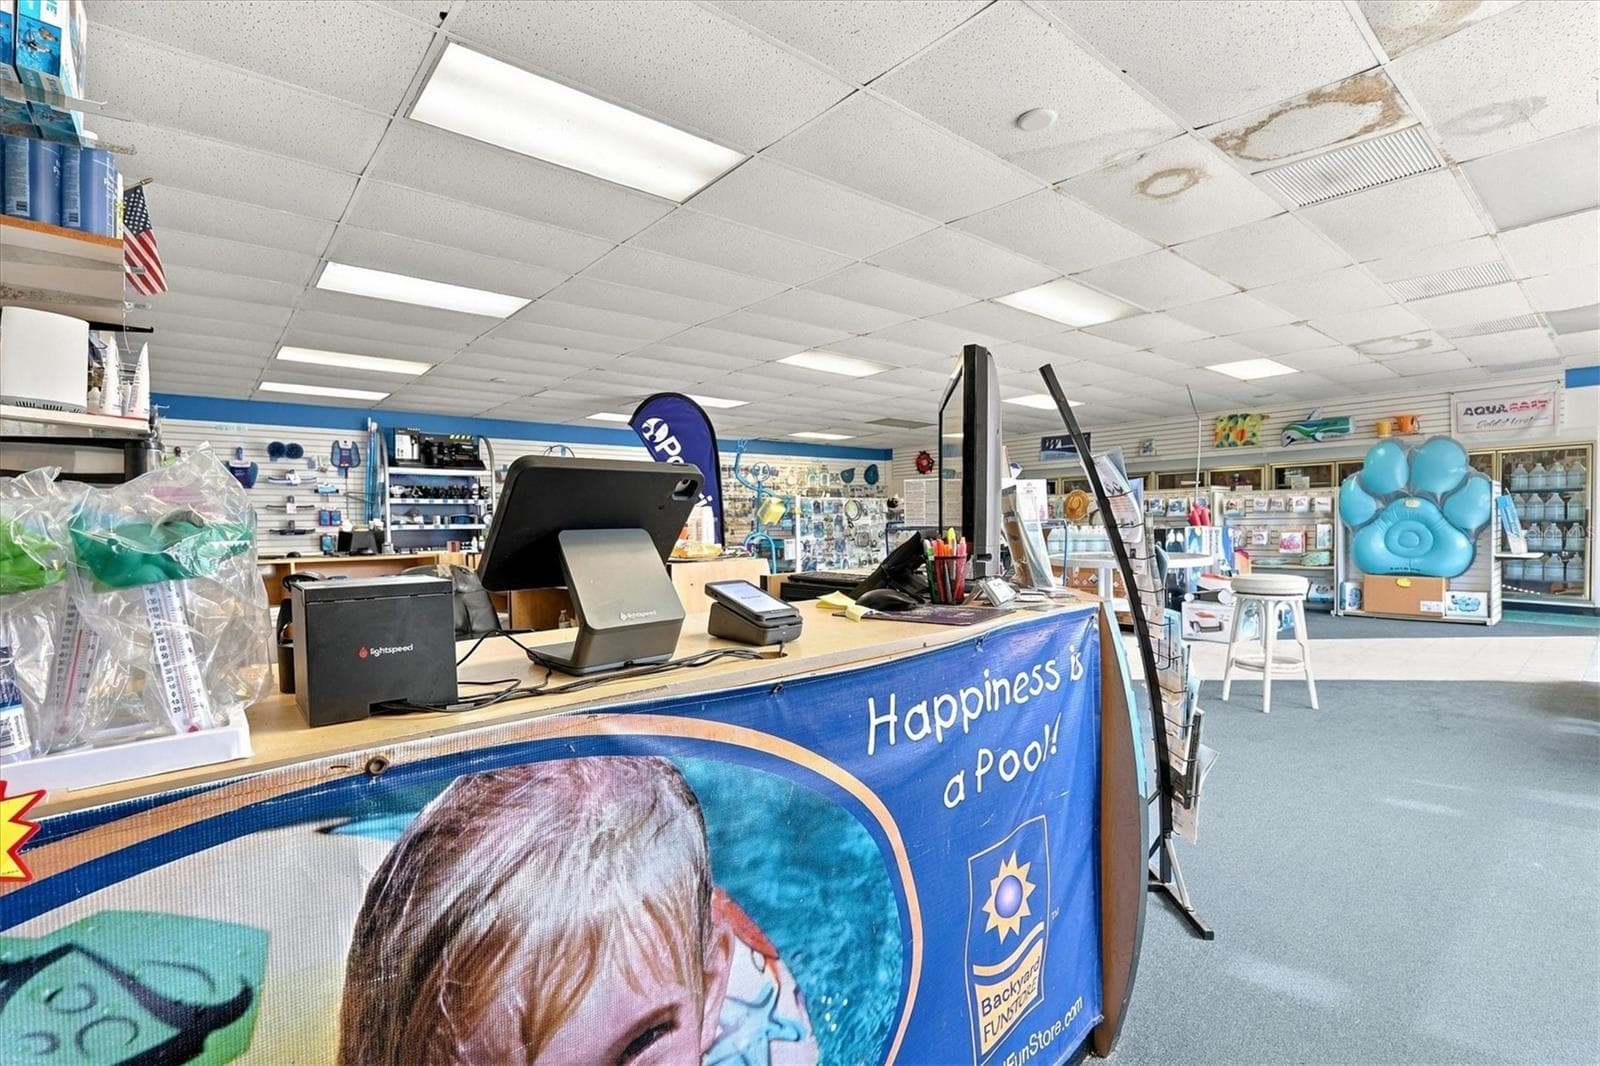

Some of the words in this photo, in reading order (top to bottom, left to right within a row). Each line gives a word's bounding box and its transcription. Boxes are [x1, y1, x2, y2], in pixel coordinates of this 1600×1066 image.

[369, 643, 415, 658] lightspeed
[866, 661, 1061, 755] Happiness
[1068, 644, 1085, 682] is
[943, 769, 966, 808] a
[975, 711, 1063, 793] Pool!
[981, 956, 1041, 1017] Backyard
[983, 976, 1038, 1043] FUNSTORE
[1003, 996, 1083, 1066] FunStore.com
